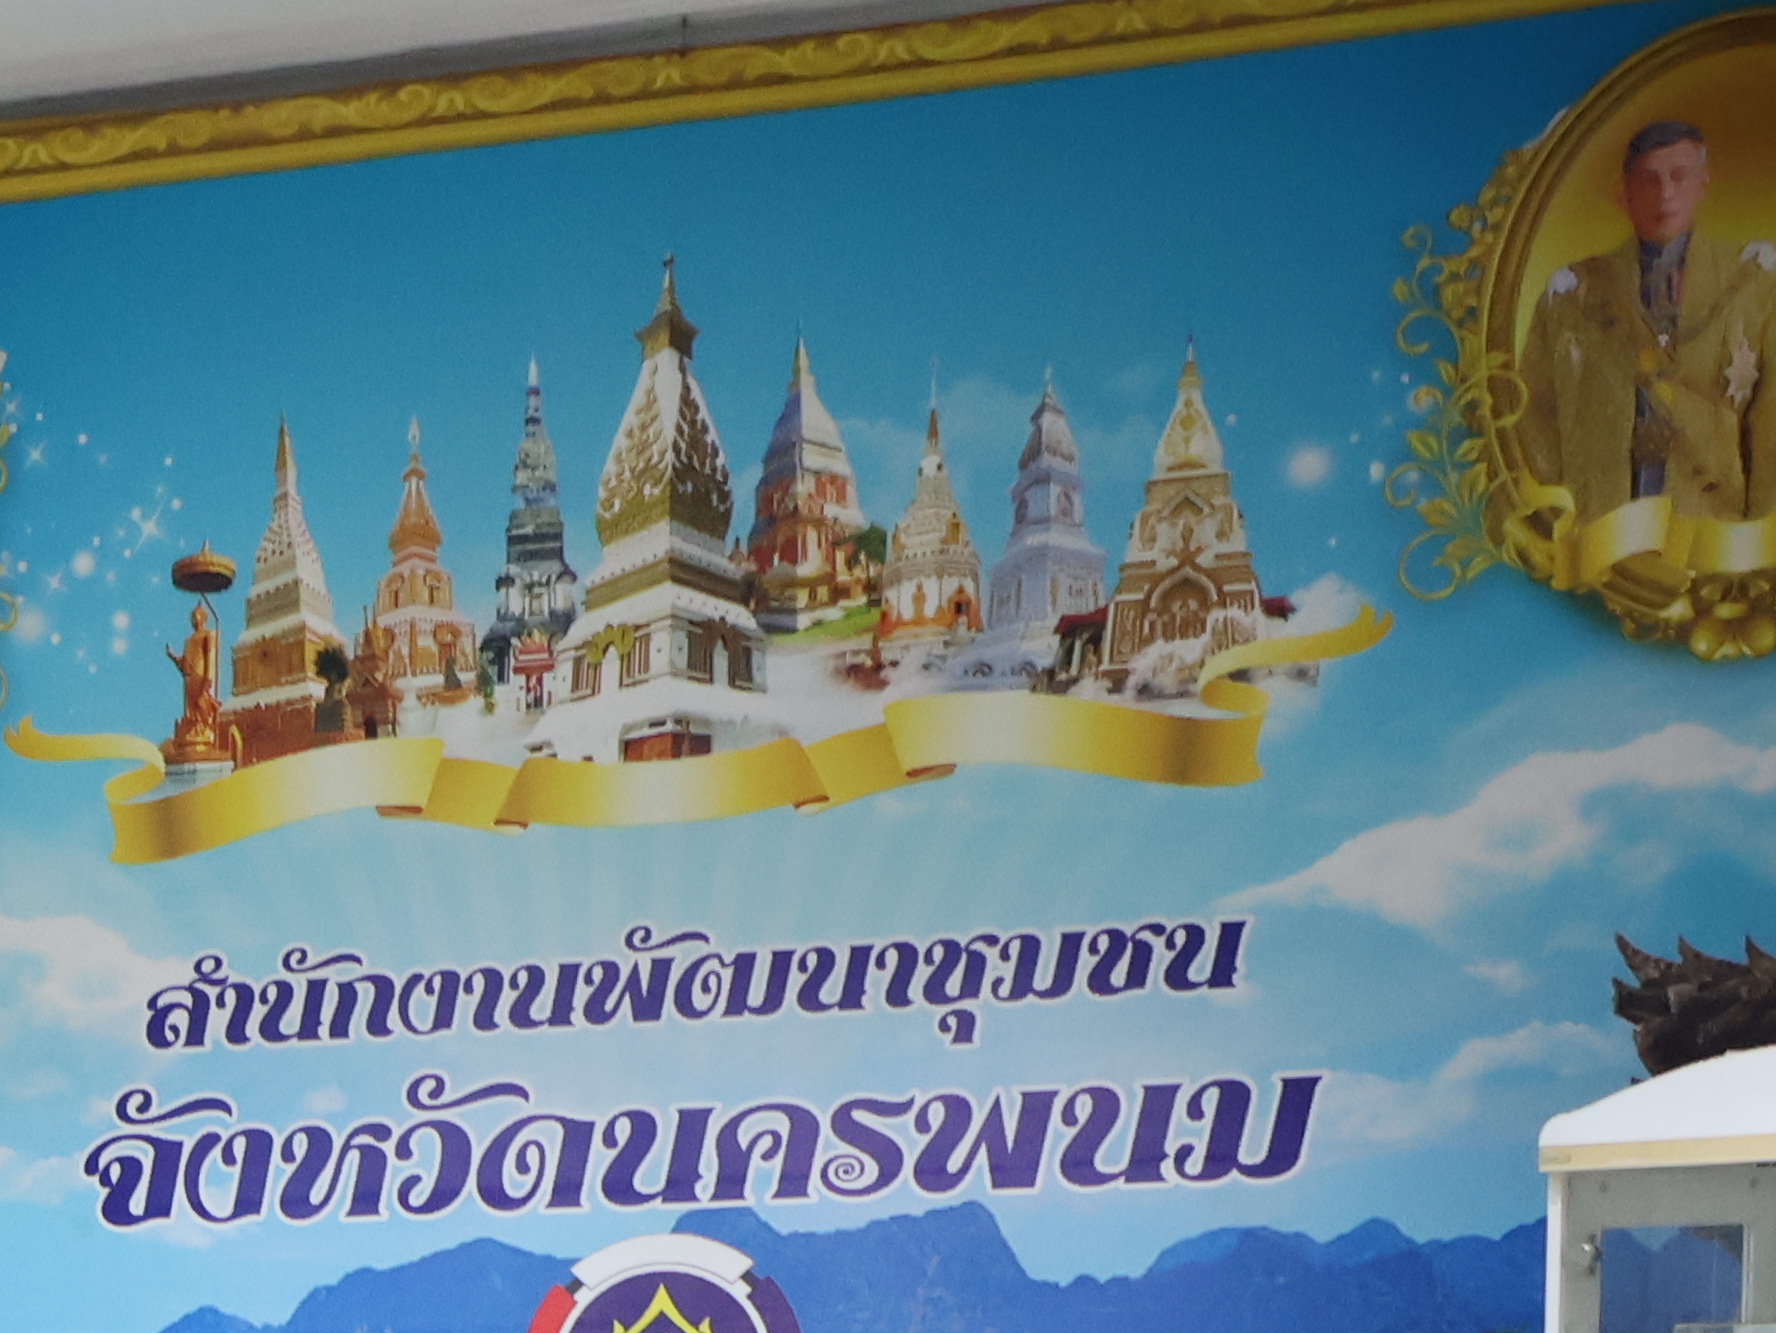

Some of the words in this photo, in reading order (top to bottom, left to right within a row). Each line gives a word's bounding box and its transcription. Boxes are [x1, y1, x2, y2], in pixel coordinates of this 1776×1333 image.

[145, 918, 1251, 1049] สำนักงานพัฒนาชุมชน
[84, 1071, 1324, 1230] จังหวัดนครพนม
